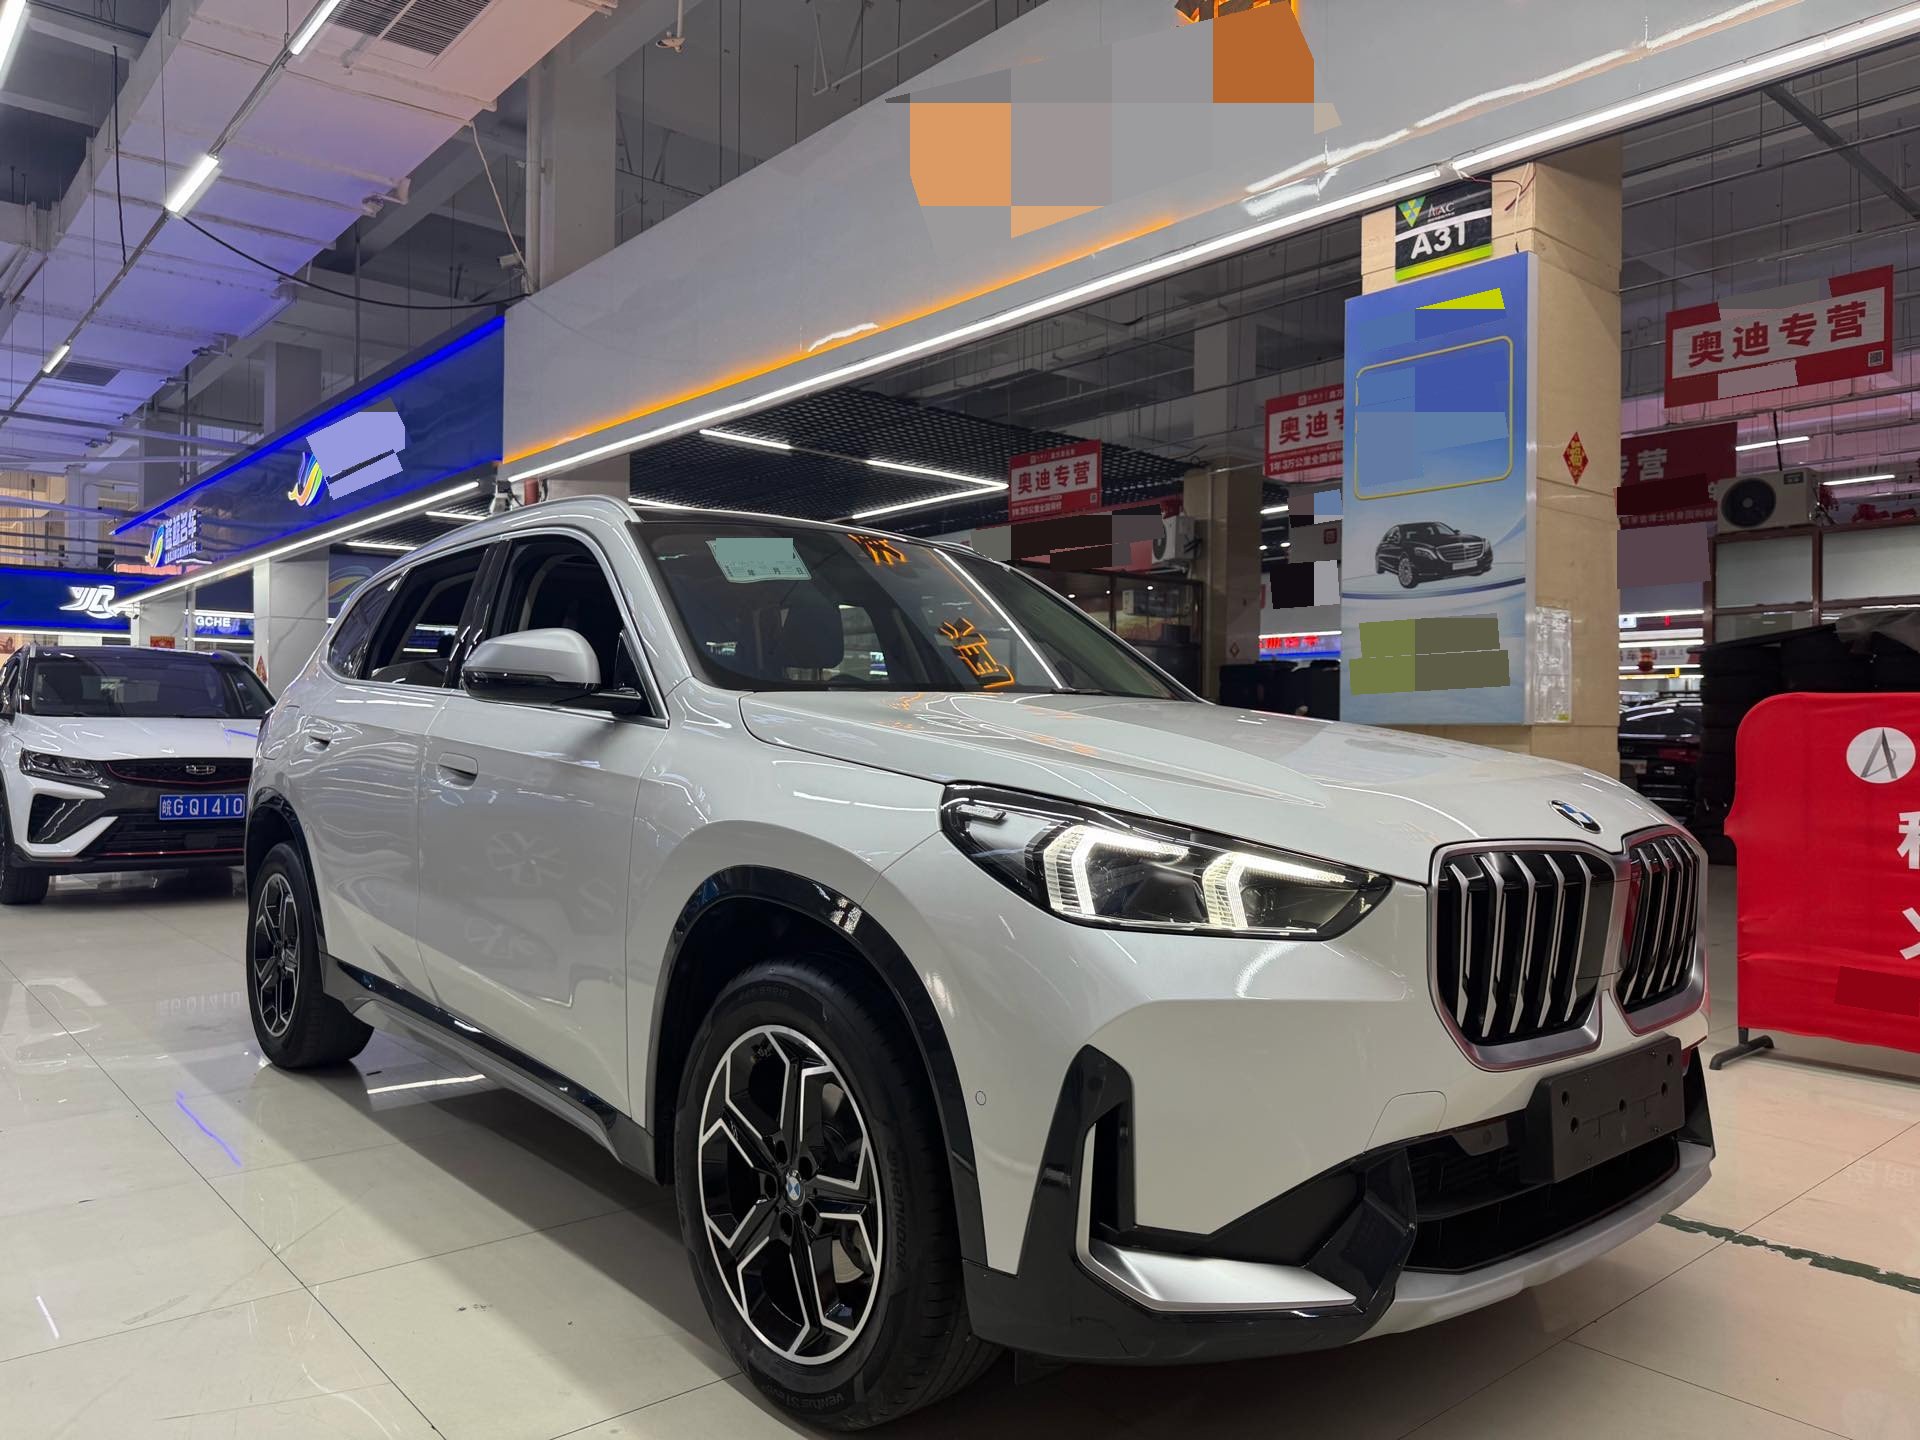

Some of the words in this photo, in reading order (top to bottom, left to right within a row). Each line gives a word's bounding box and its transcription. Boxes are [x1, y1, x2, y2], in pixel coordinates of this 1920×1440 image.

[1410, 221, 1465, 259] A31
[1688, 301, 1866, 368] 奥迪专营
[1018, 461, 1090, 495] 奥迪专营
[1621, 448, 1667, 485] 营
